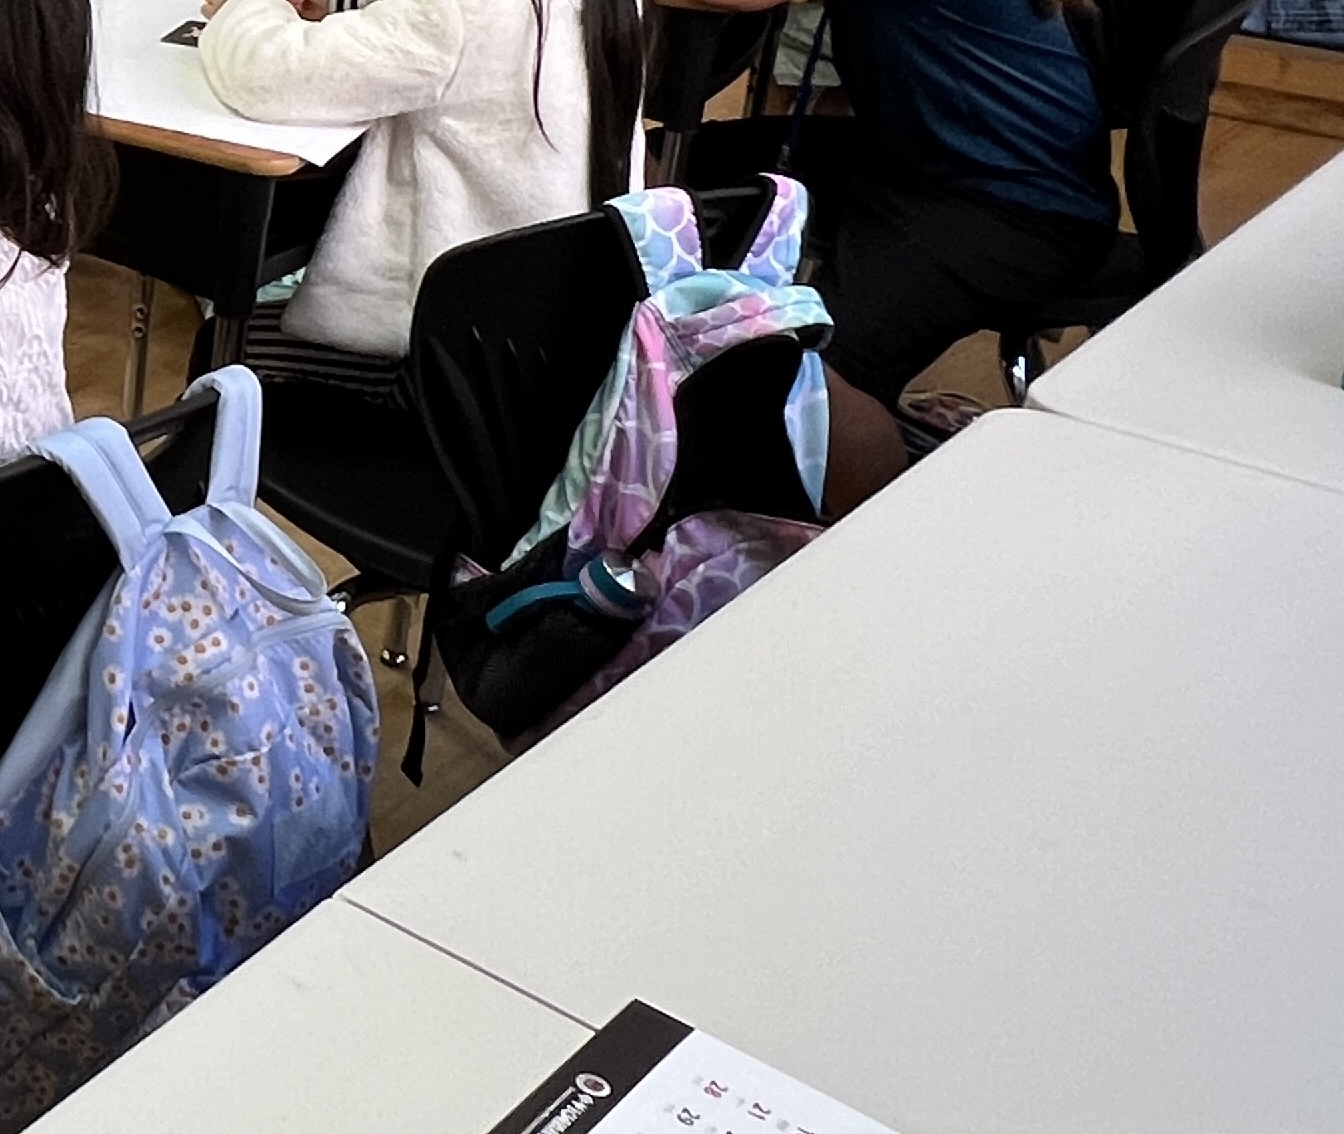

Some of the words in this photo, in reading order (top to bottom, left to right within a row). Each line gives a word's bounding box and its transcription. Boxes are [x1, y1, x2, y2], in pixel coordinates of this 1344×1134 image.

[703, 1079, 729, 1098] 28
[676, 1107, 701, 1126] 29
[746, 1102, 772, 1121] 21
